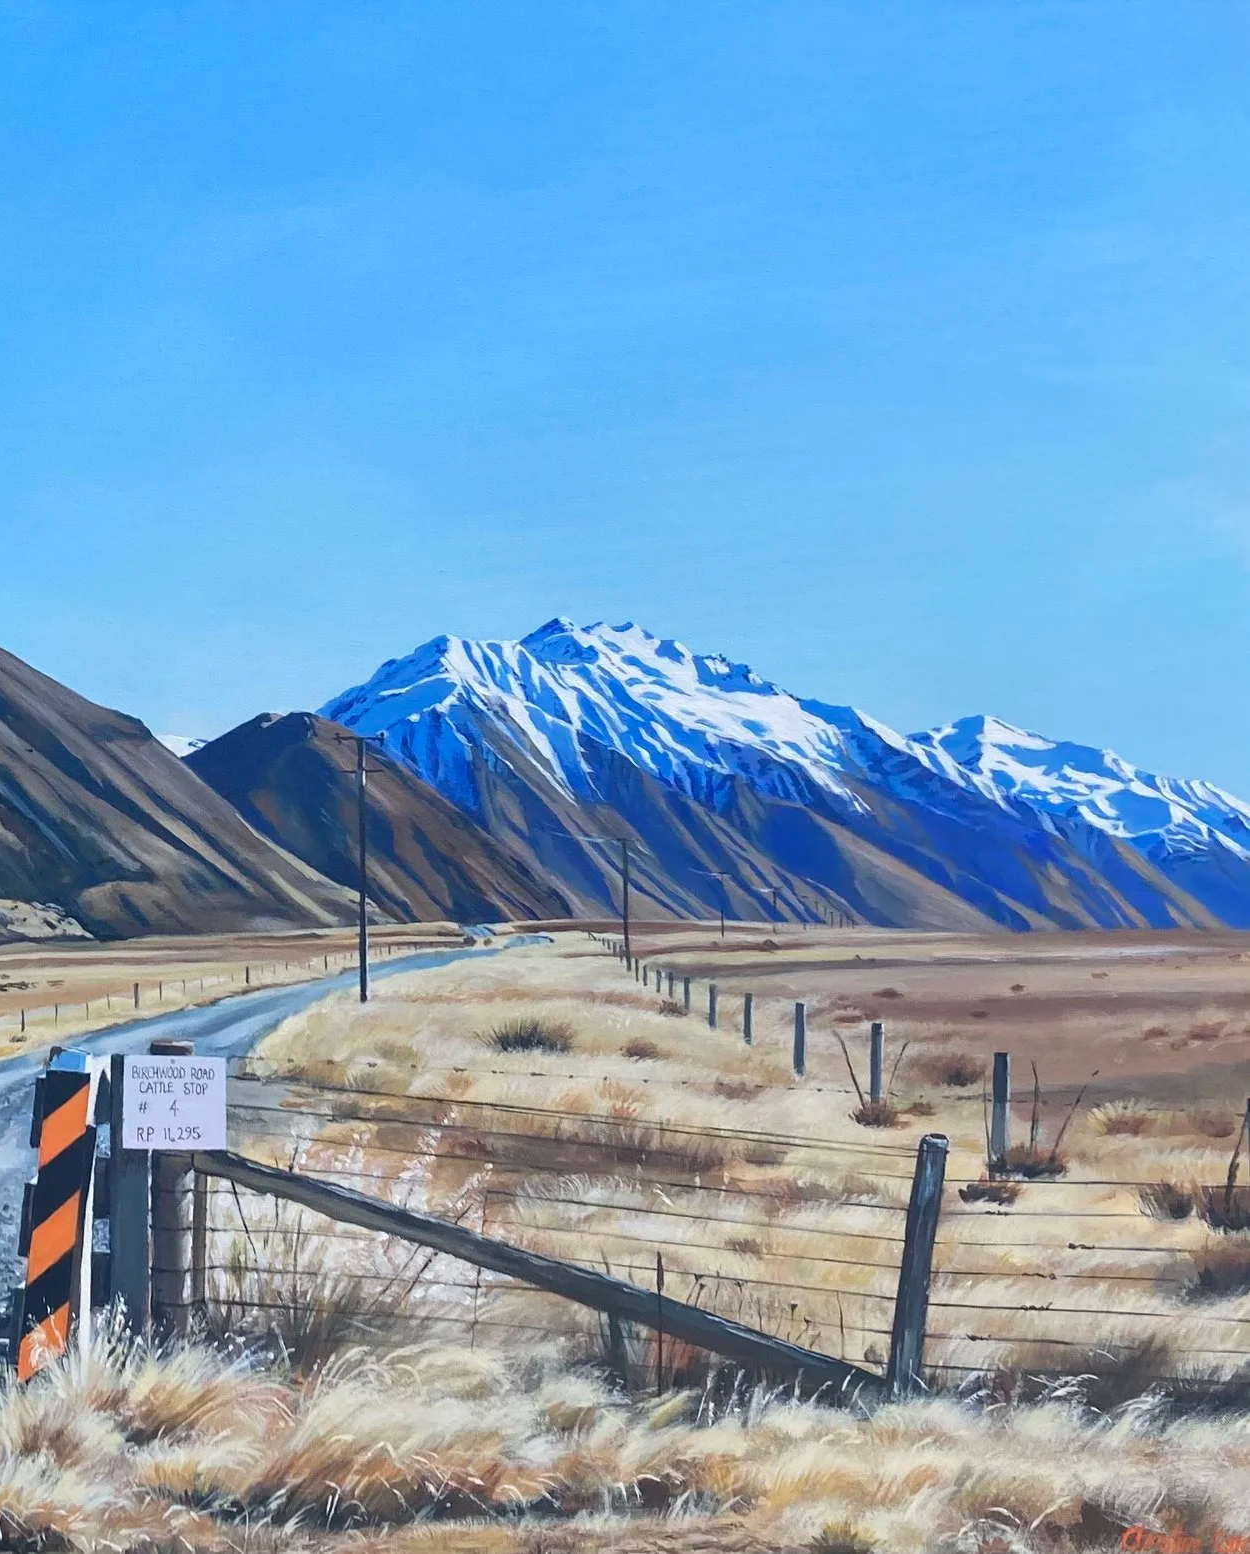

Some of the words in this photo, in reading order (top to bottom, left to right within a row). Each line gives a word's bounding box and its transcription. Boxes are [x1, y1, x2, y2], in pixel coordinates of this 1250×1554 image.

[131, 1065, 185, 1079] BIRCHWOOD
[190, 1067, 215, 1080] ROAD
[139, 1081, 175, 1094] CATTLE
[183, 1082, 208, 1095] STOP
[169, 1100, 178, 1117] 4
